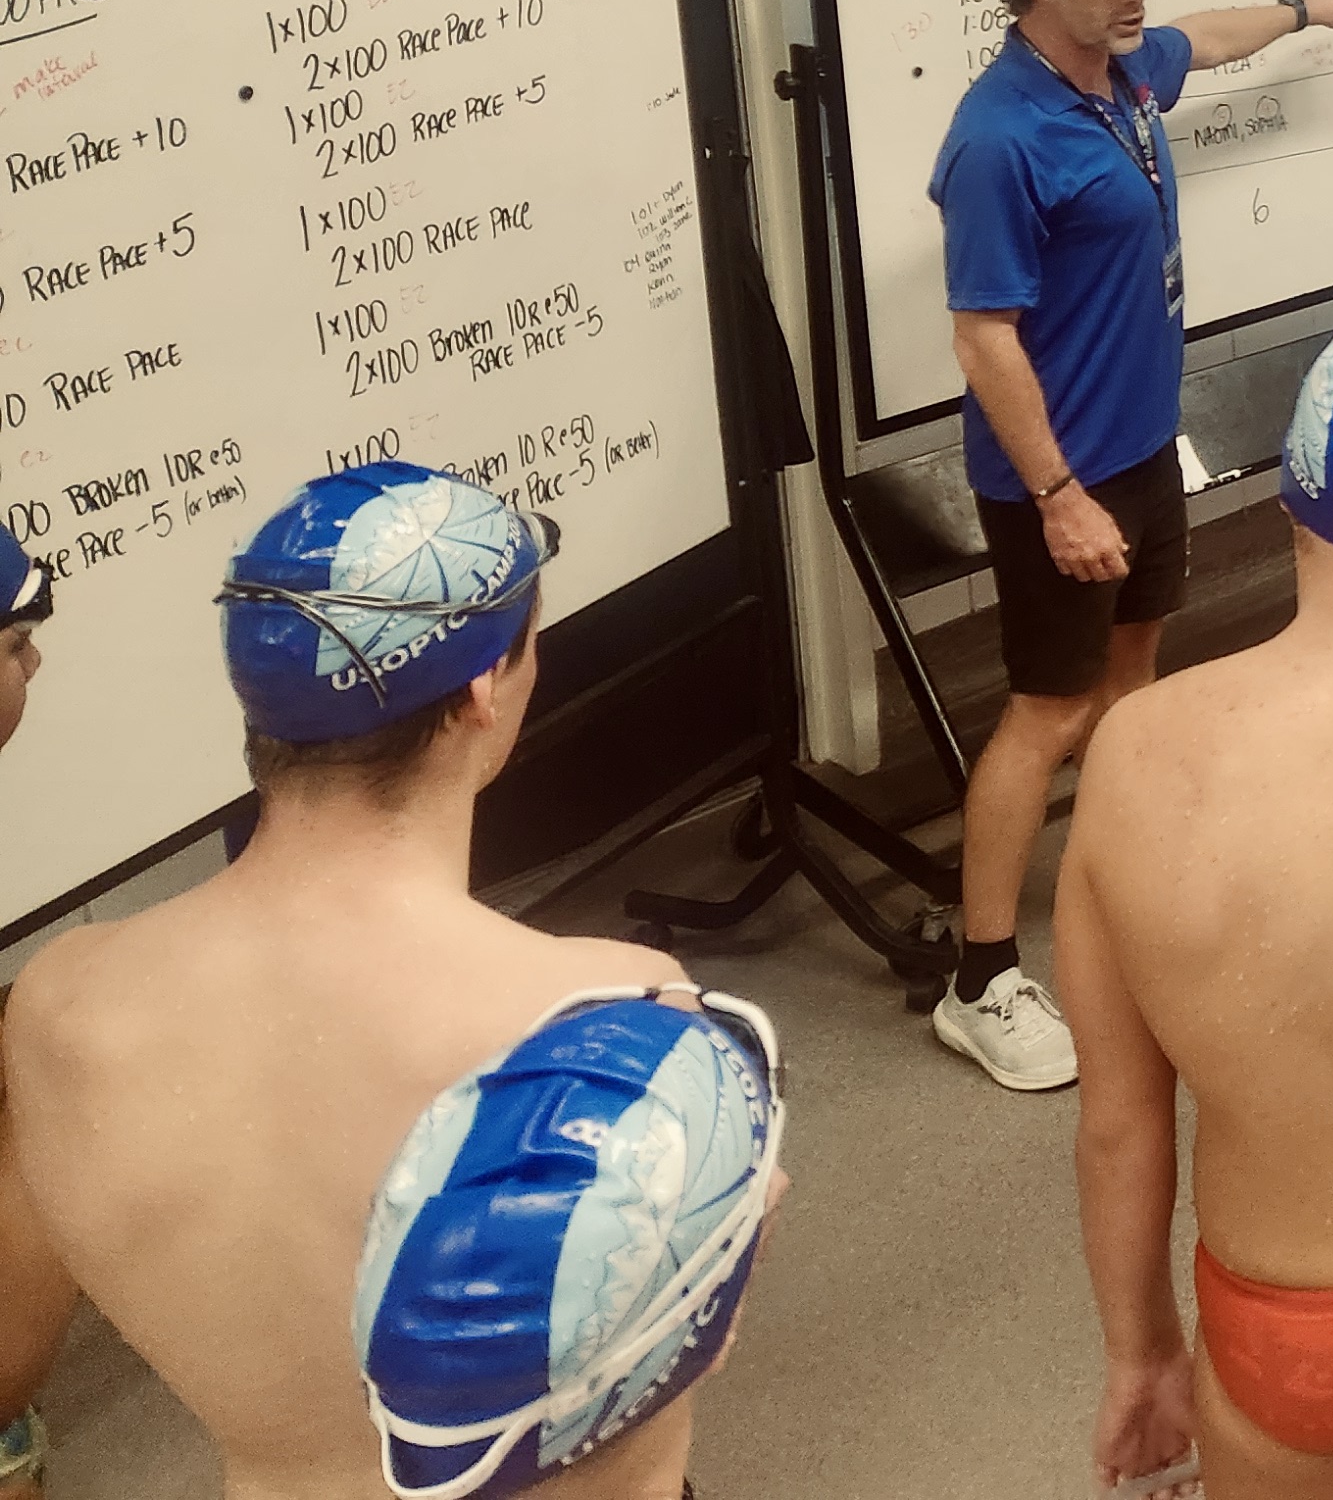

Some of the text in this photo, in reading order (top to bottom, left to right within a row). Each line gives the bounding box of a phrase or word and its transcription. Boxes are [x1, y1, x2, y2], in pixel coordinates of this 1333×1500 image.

[964, 6, 1009, 35] 1:08
[5, 151, 66, 193] RACE
[1252, 188, 1271, 225] 6
[422, 215, 480, 255] RACE
[22, 261, 91, 302] RACE
[99, 242, 148, 281] PACE
[468, 344, 514, 382] RACE
[522, 325, 567, 360] PACE
[42, 342, 182, 412] RACE PACE
